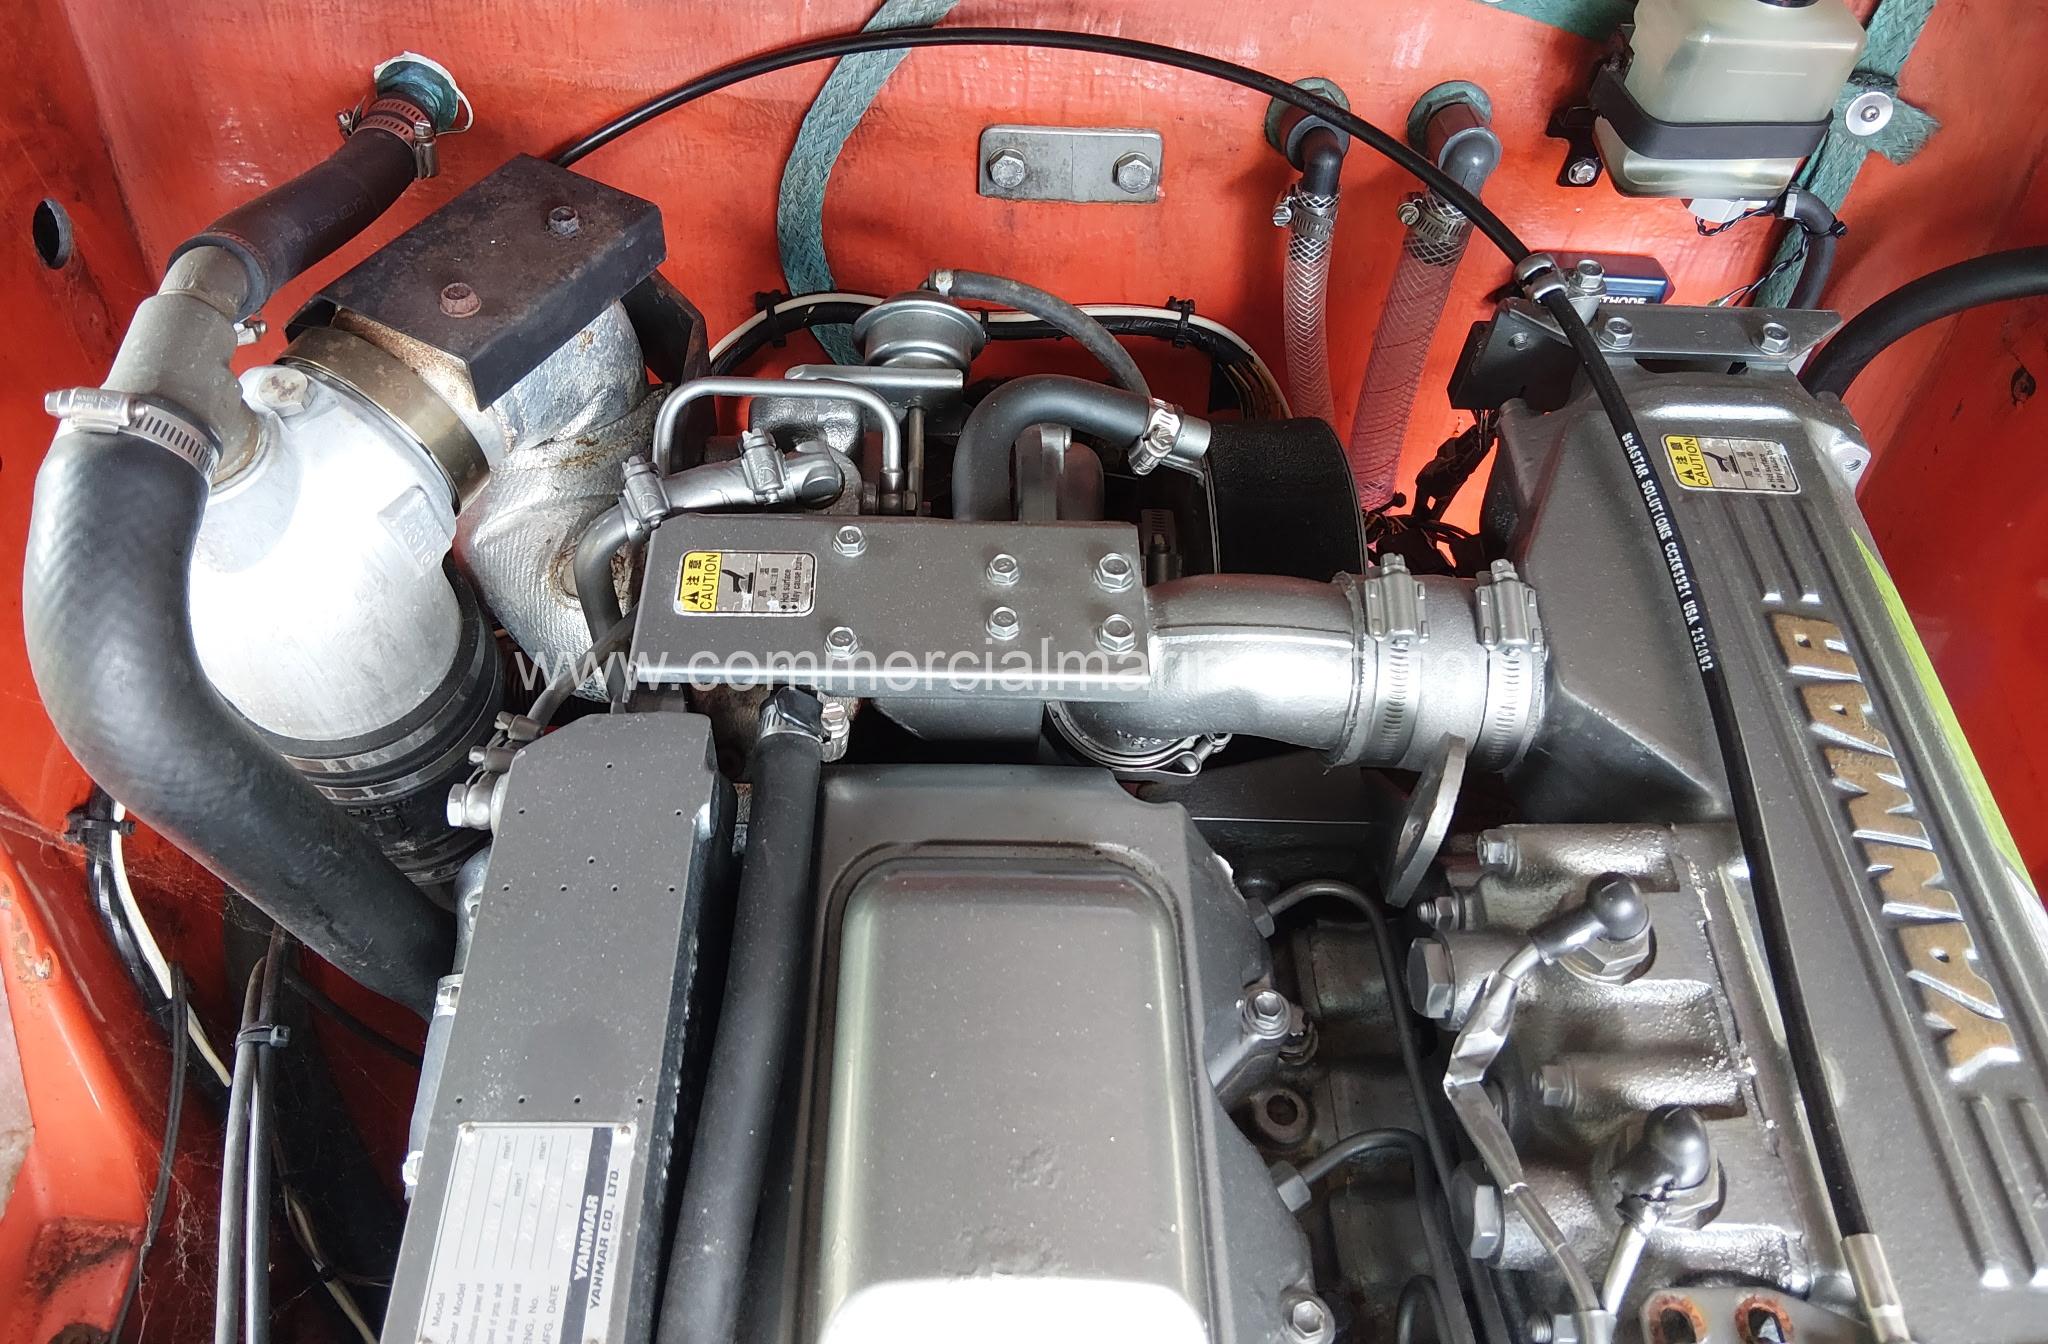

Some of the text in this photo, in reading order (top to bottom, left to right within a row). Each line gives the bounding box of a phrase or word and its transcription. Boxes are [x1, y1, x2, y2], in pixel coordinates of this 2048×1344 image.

[1683, 438, 1710, 486] CAUTION
[1641, 479, 1673, 540] SOLUTIONS
[686, 560, 702, 586] 注意
[700, 554, 718, 610] CAUTION
[1683, 600, 1700, 626] USA
[1691, 627, 1714, 672] 232092
[1768, 612, 2021, 1084] YANMAR
[574, 1194, 600, 1281] YANMAR
[589, 1237, 609, 1310] YANMAR
[606, 1167, 619, 1198] LTD.
[432, 1292, 446, 1327] Model
[452, 1282, 466, 1317] Model
[546, 1284, 560, 1315] DATE
